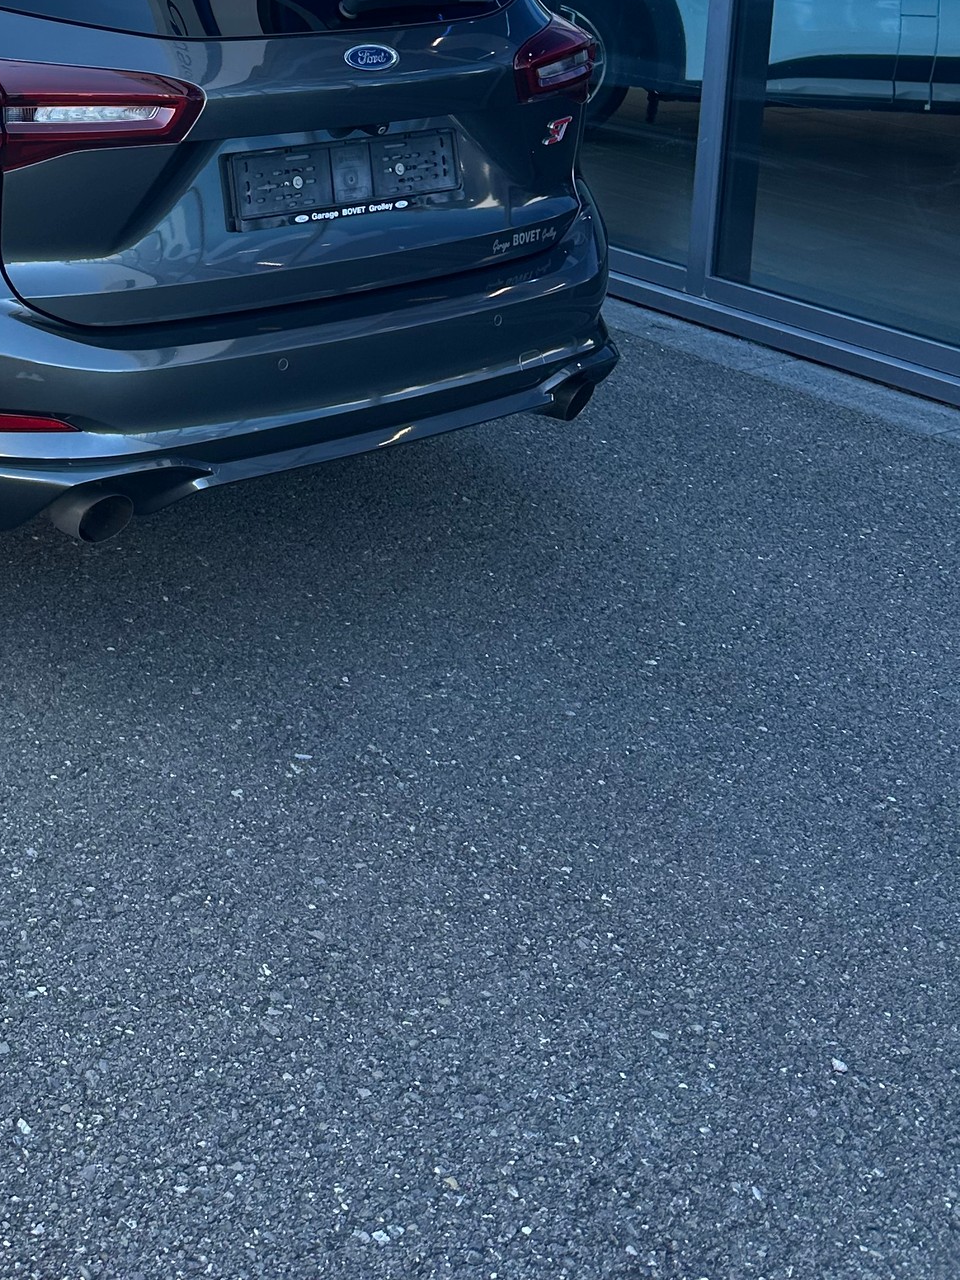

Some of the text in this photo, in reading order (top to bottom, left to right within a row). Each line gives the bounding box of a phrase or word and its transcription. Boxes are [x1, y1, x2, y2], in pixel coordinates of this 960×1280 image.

[357, 49, 387, 65] Ford
[311, 210, 339, 220] Garage
[342, 206, 366, 216] BOVET
[368, 202, 393, 212] Grolley
[512, 228, 541, 246] BOVET
